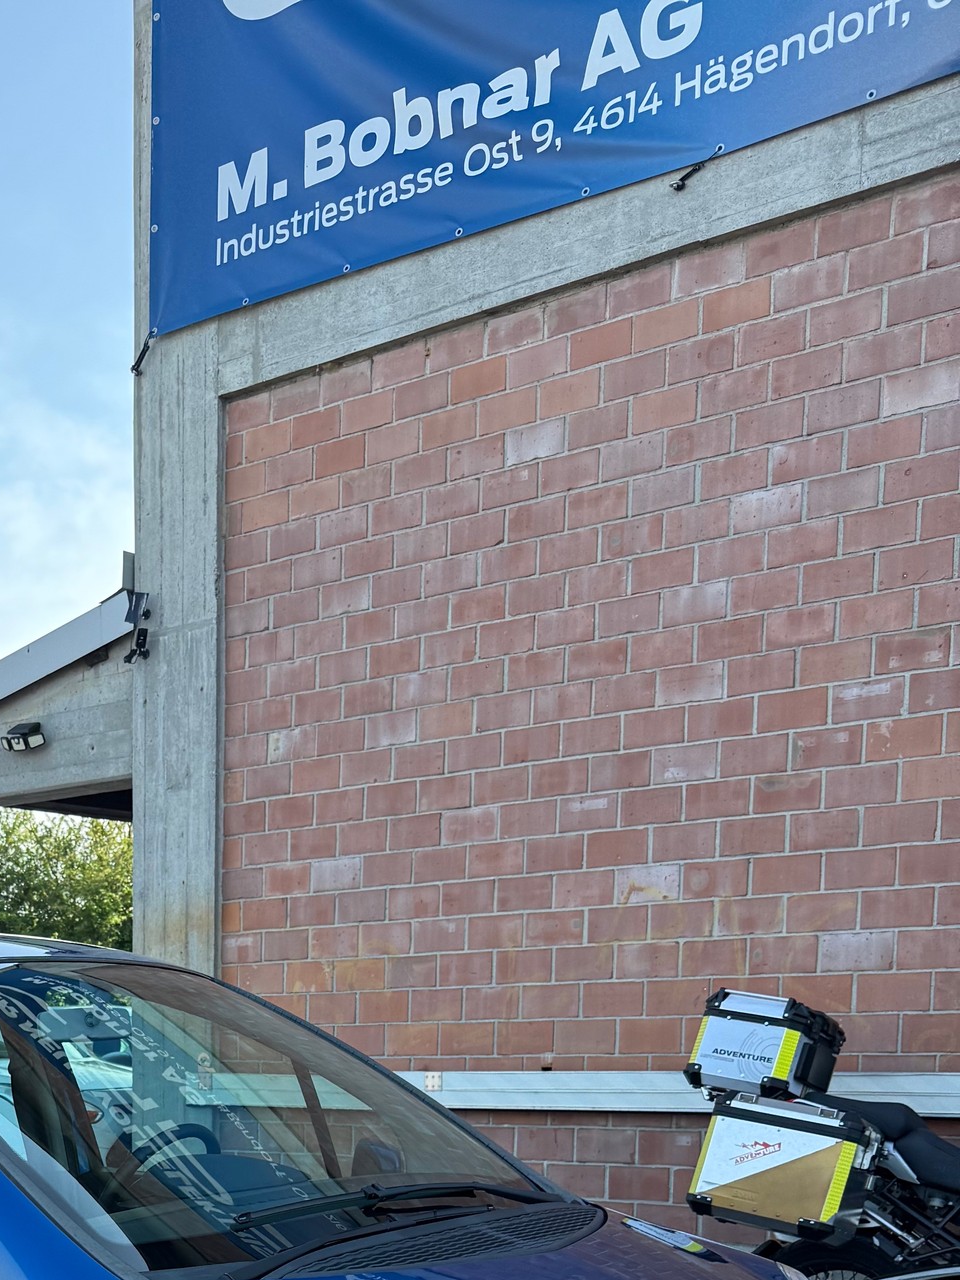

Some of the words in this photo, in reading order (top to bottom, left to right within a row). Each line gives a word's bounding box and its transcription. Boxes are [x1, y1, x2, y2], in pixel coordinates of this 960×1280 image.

[215, 160, 454, 266] Industriestrasse
[463, 129, 523, 177] Ost
[531, 118, 562, 154] 9,
[573, 82, 662, 136] 4614
[674, 0, 911, 107] Hägendorf,
[216, 147, 288, 222] M.
[303, 48, 560, 189] Bobnar
[580, 0, 703, 92] AG
[712, 1048, 774, 1064] ADVENTURE
